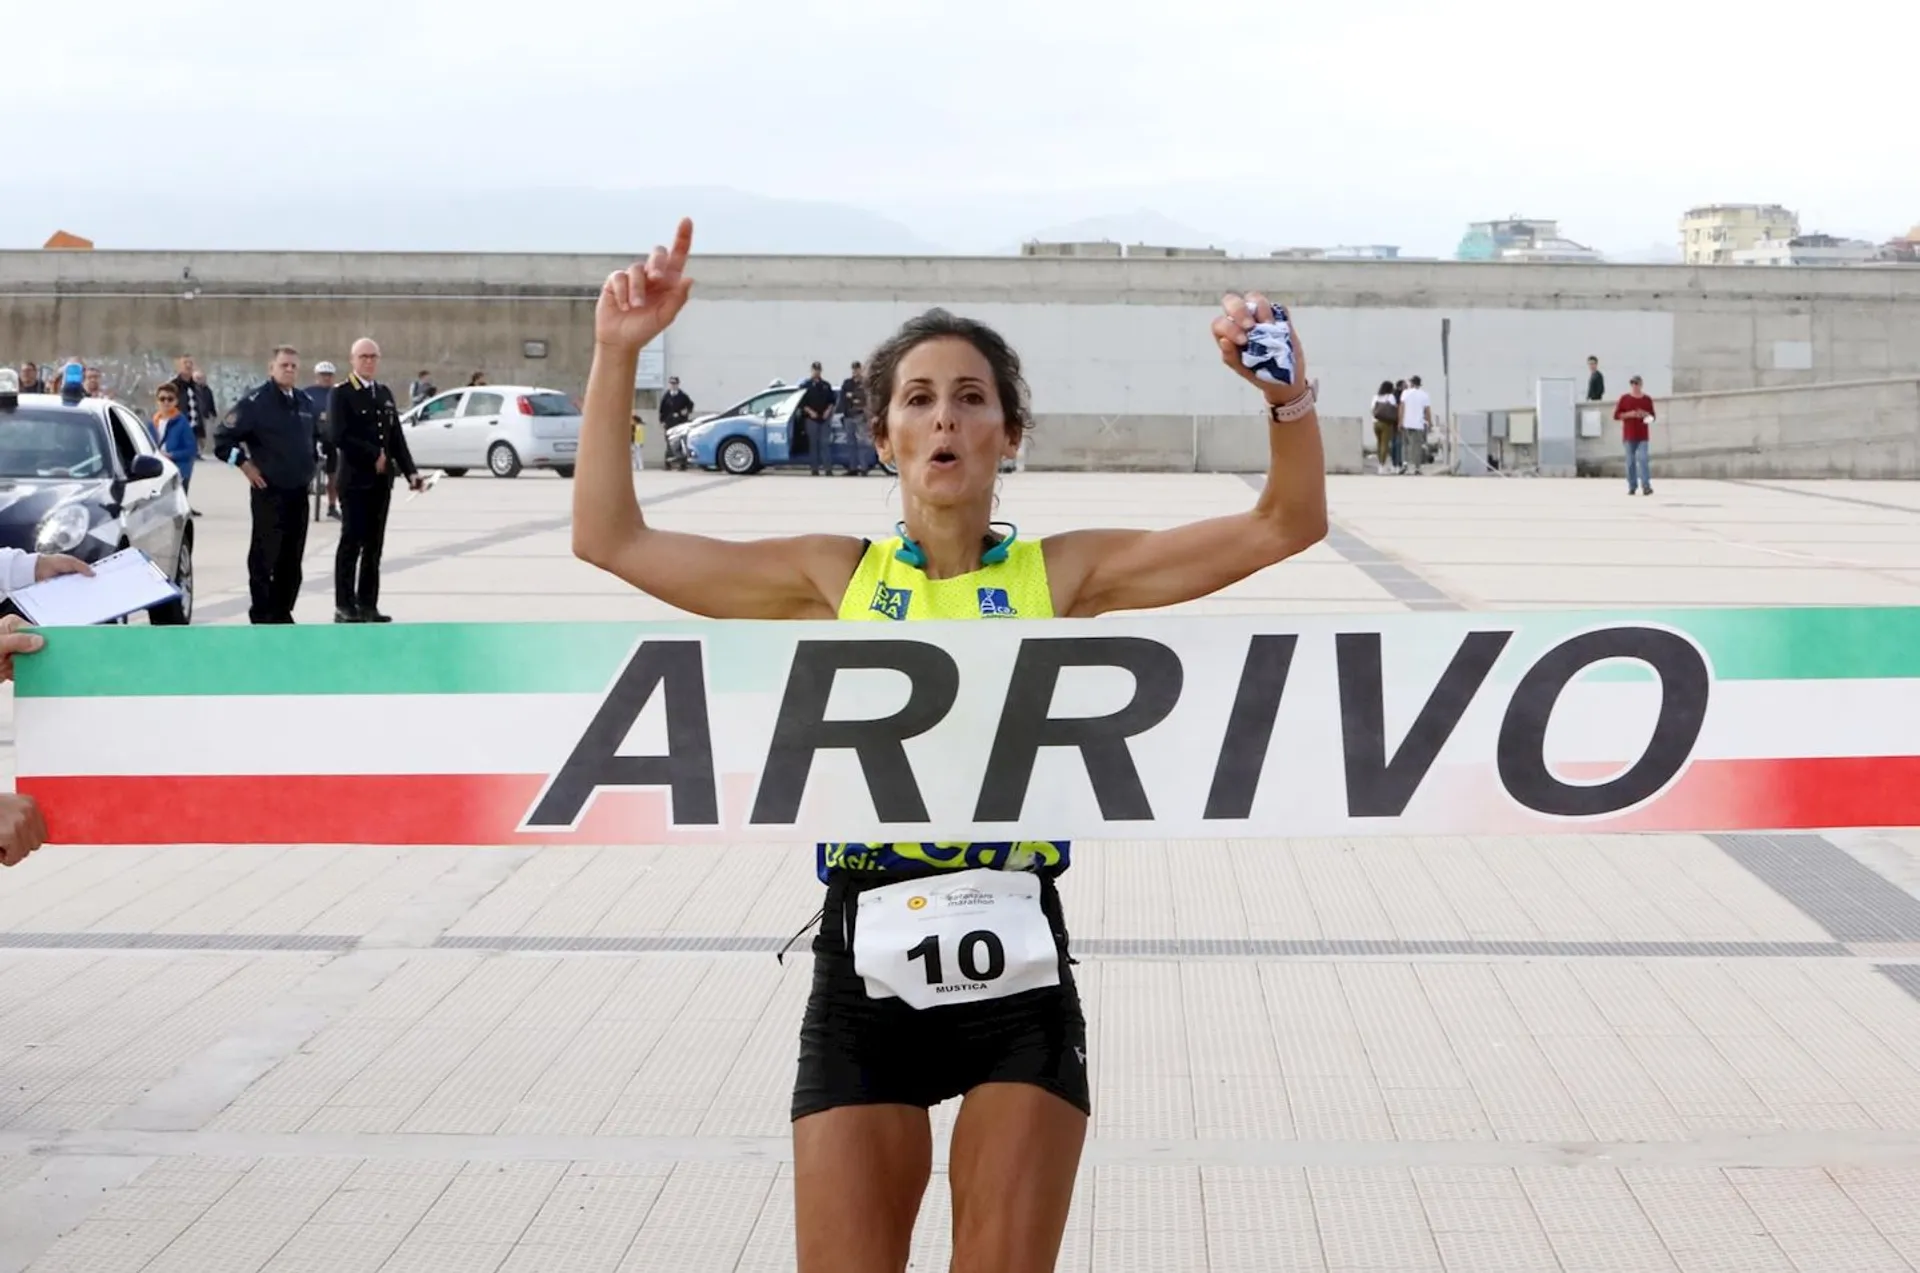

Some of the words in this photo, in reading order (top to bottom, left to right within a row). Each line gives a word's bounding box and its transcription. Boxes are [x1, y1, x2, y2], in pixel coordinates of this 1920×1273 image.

[526, 627, 1709, 826] ARRIVO
[907, 930, 1006, 985] 10
[936, 983, 988, 994] MUSTICA
